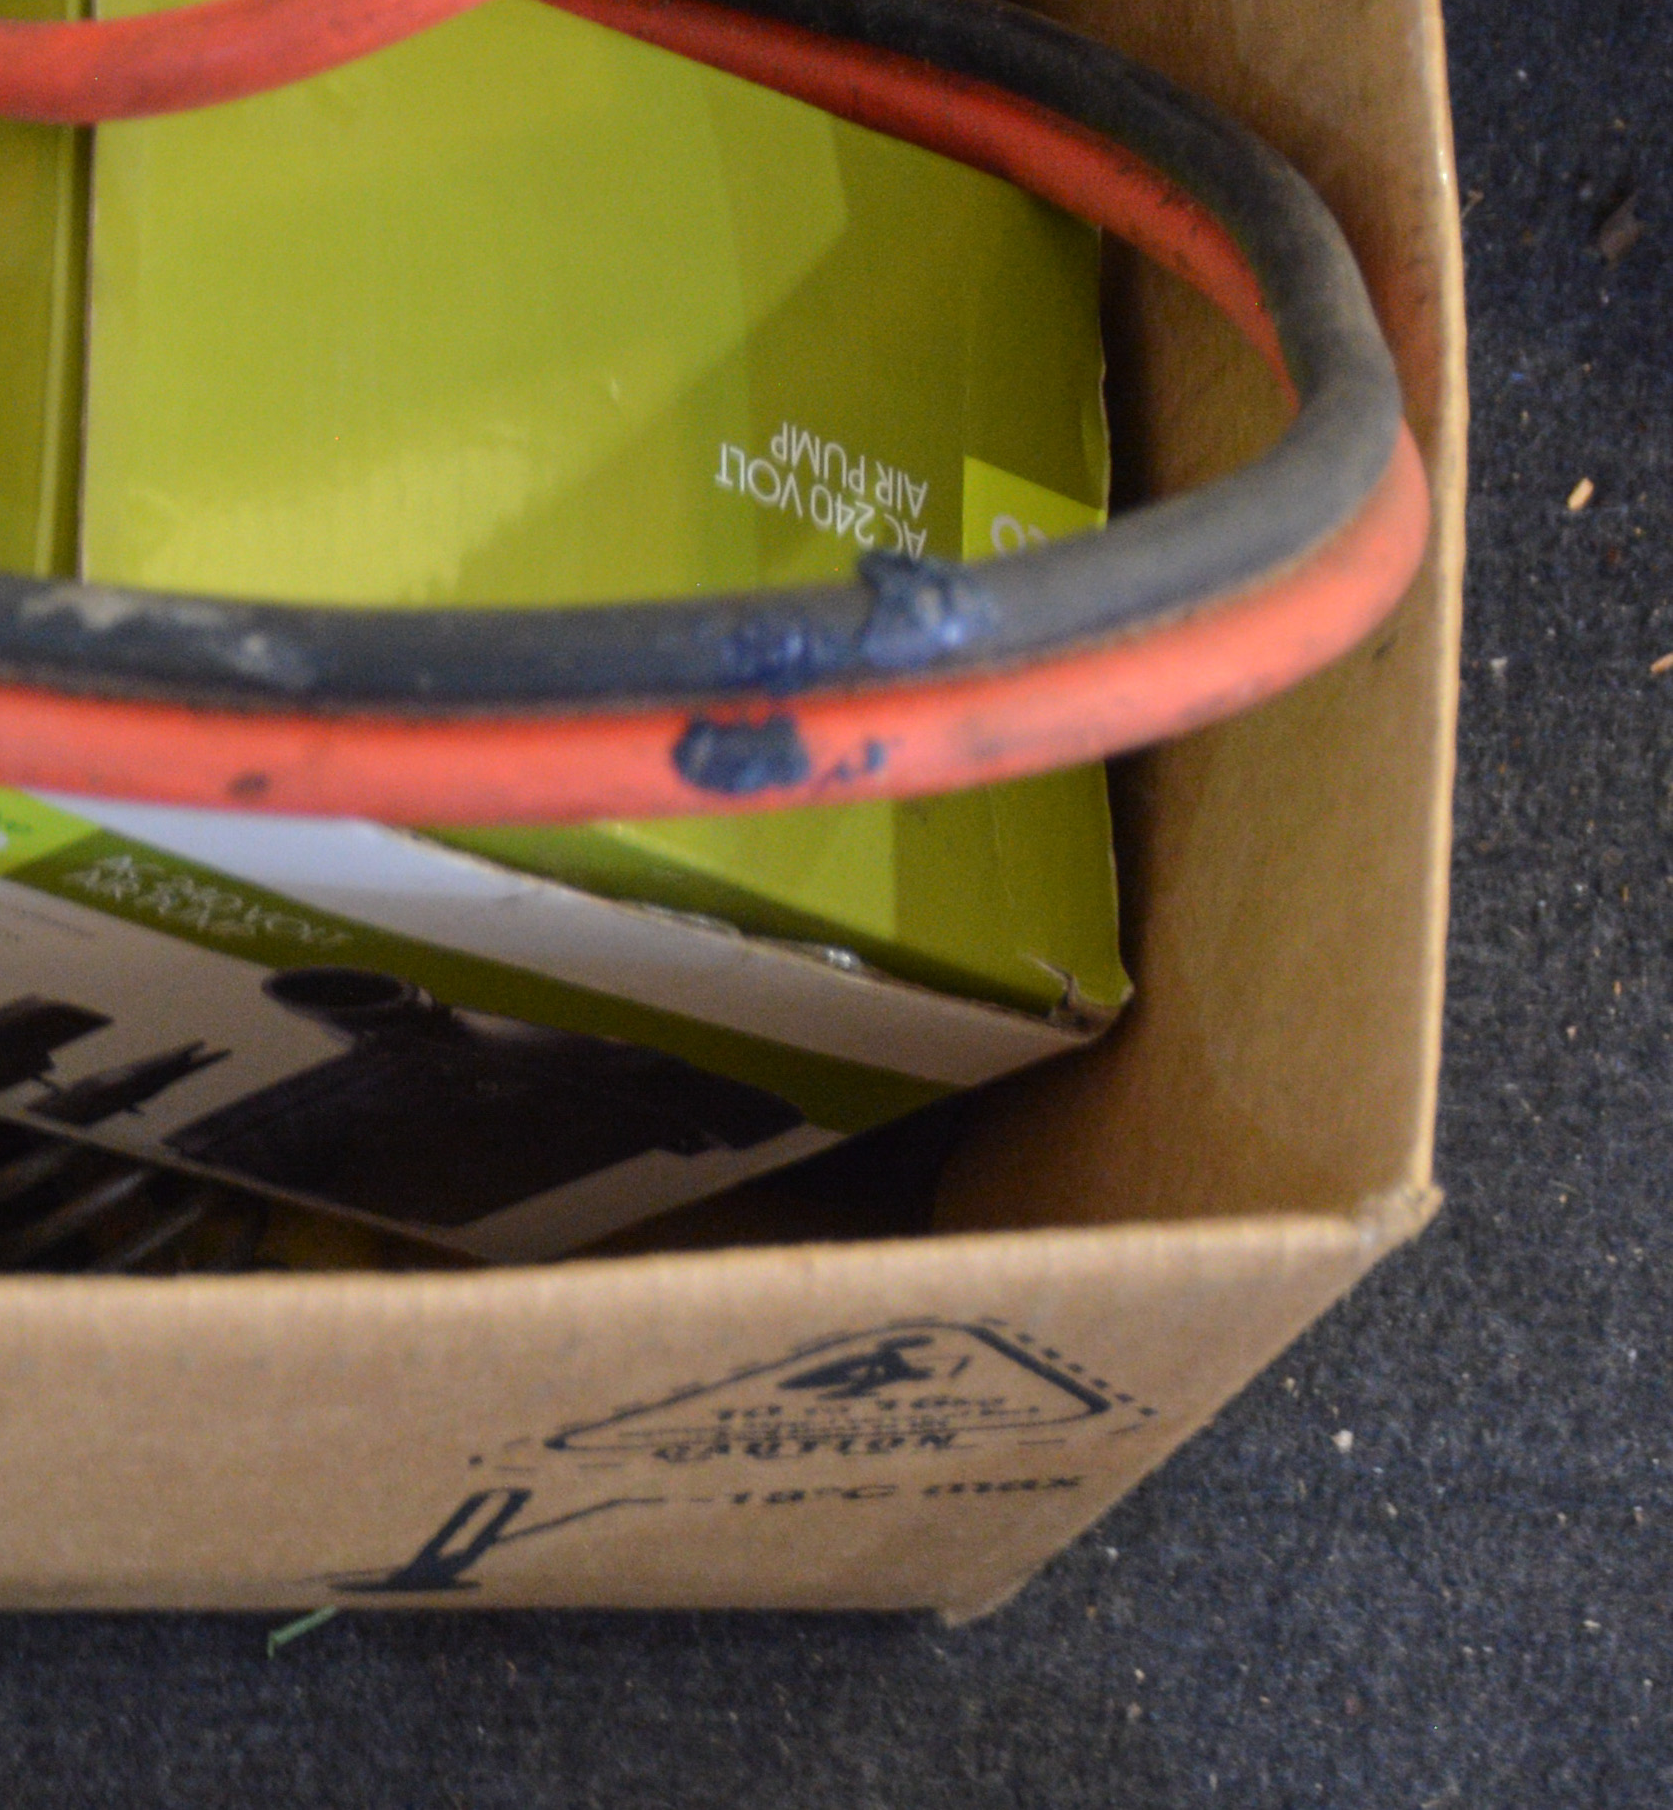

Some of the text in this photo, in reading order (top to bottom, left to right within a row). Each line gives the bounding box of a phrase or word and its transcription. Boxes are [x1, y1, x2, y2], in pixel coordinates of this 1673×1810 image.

[714, 442, 804, 520] VOLT
[769, 420, 929, 520] AIR PUMP
[809, 484, 876, 551] 240
[883, 512, 928, 562] AC
